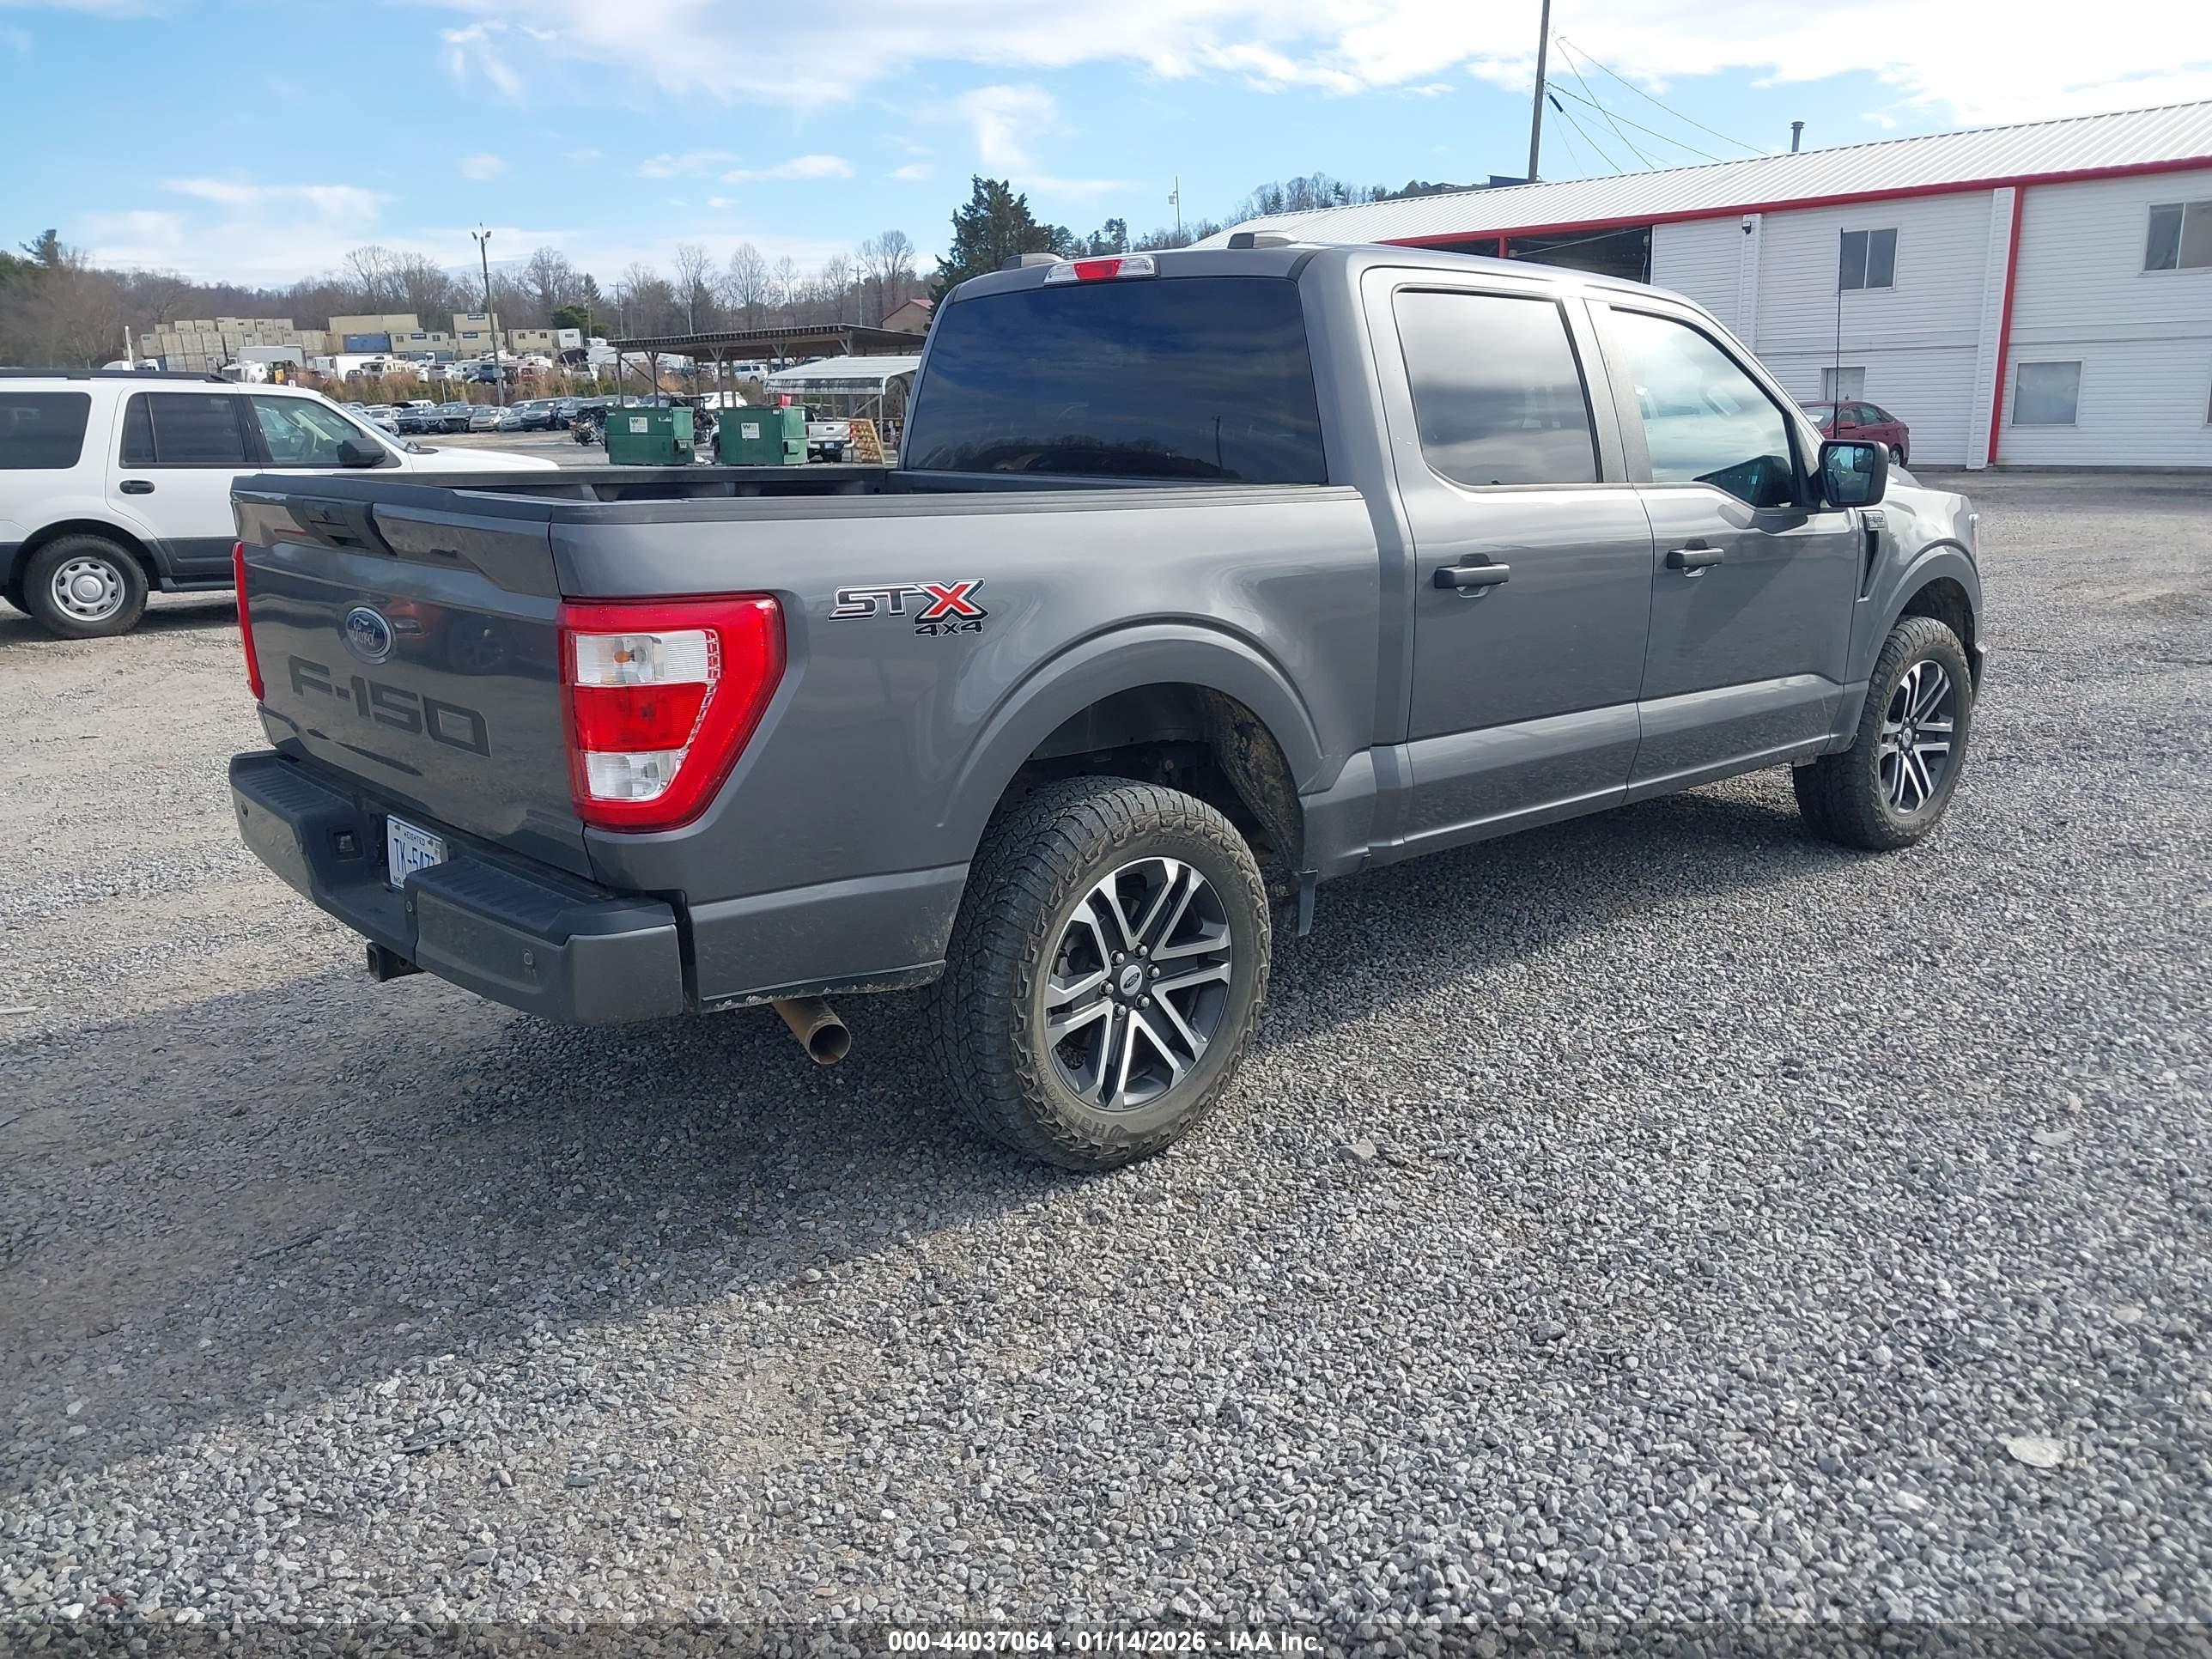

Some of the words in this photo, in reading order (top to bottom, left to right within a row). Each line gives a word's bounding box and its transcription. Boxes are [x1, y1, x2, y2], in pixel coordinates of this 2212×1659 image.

[828, 578, 989, 625] STX
[289, 655, 493, 757] F-150
[393, 838, 434, 873] TK-547
